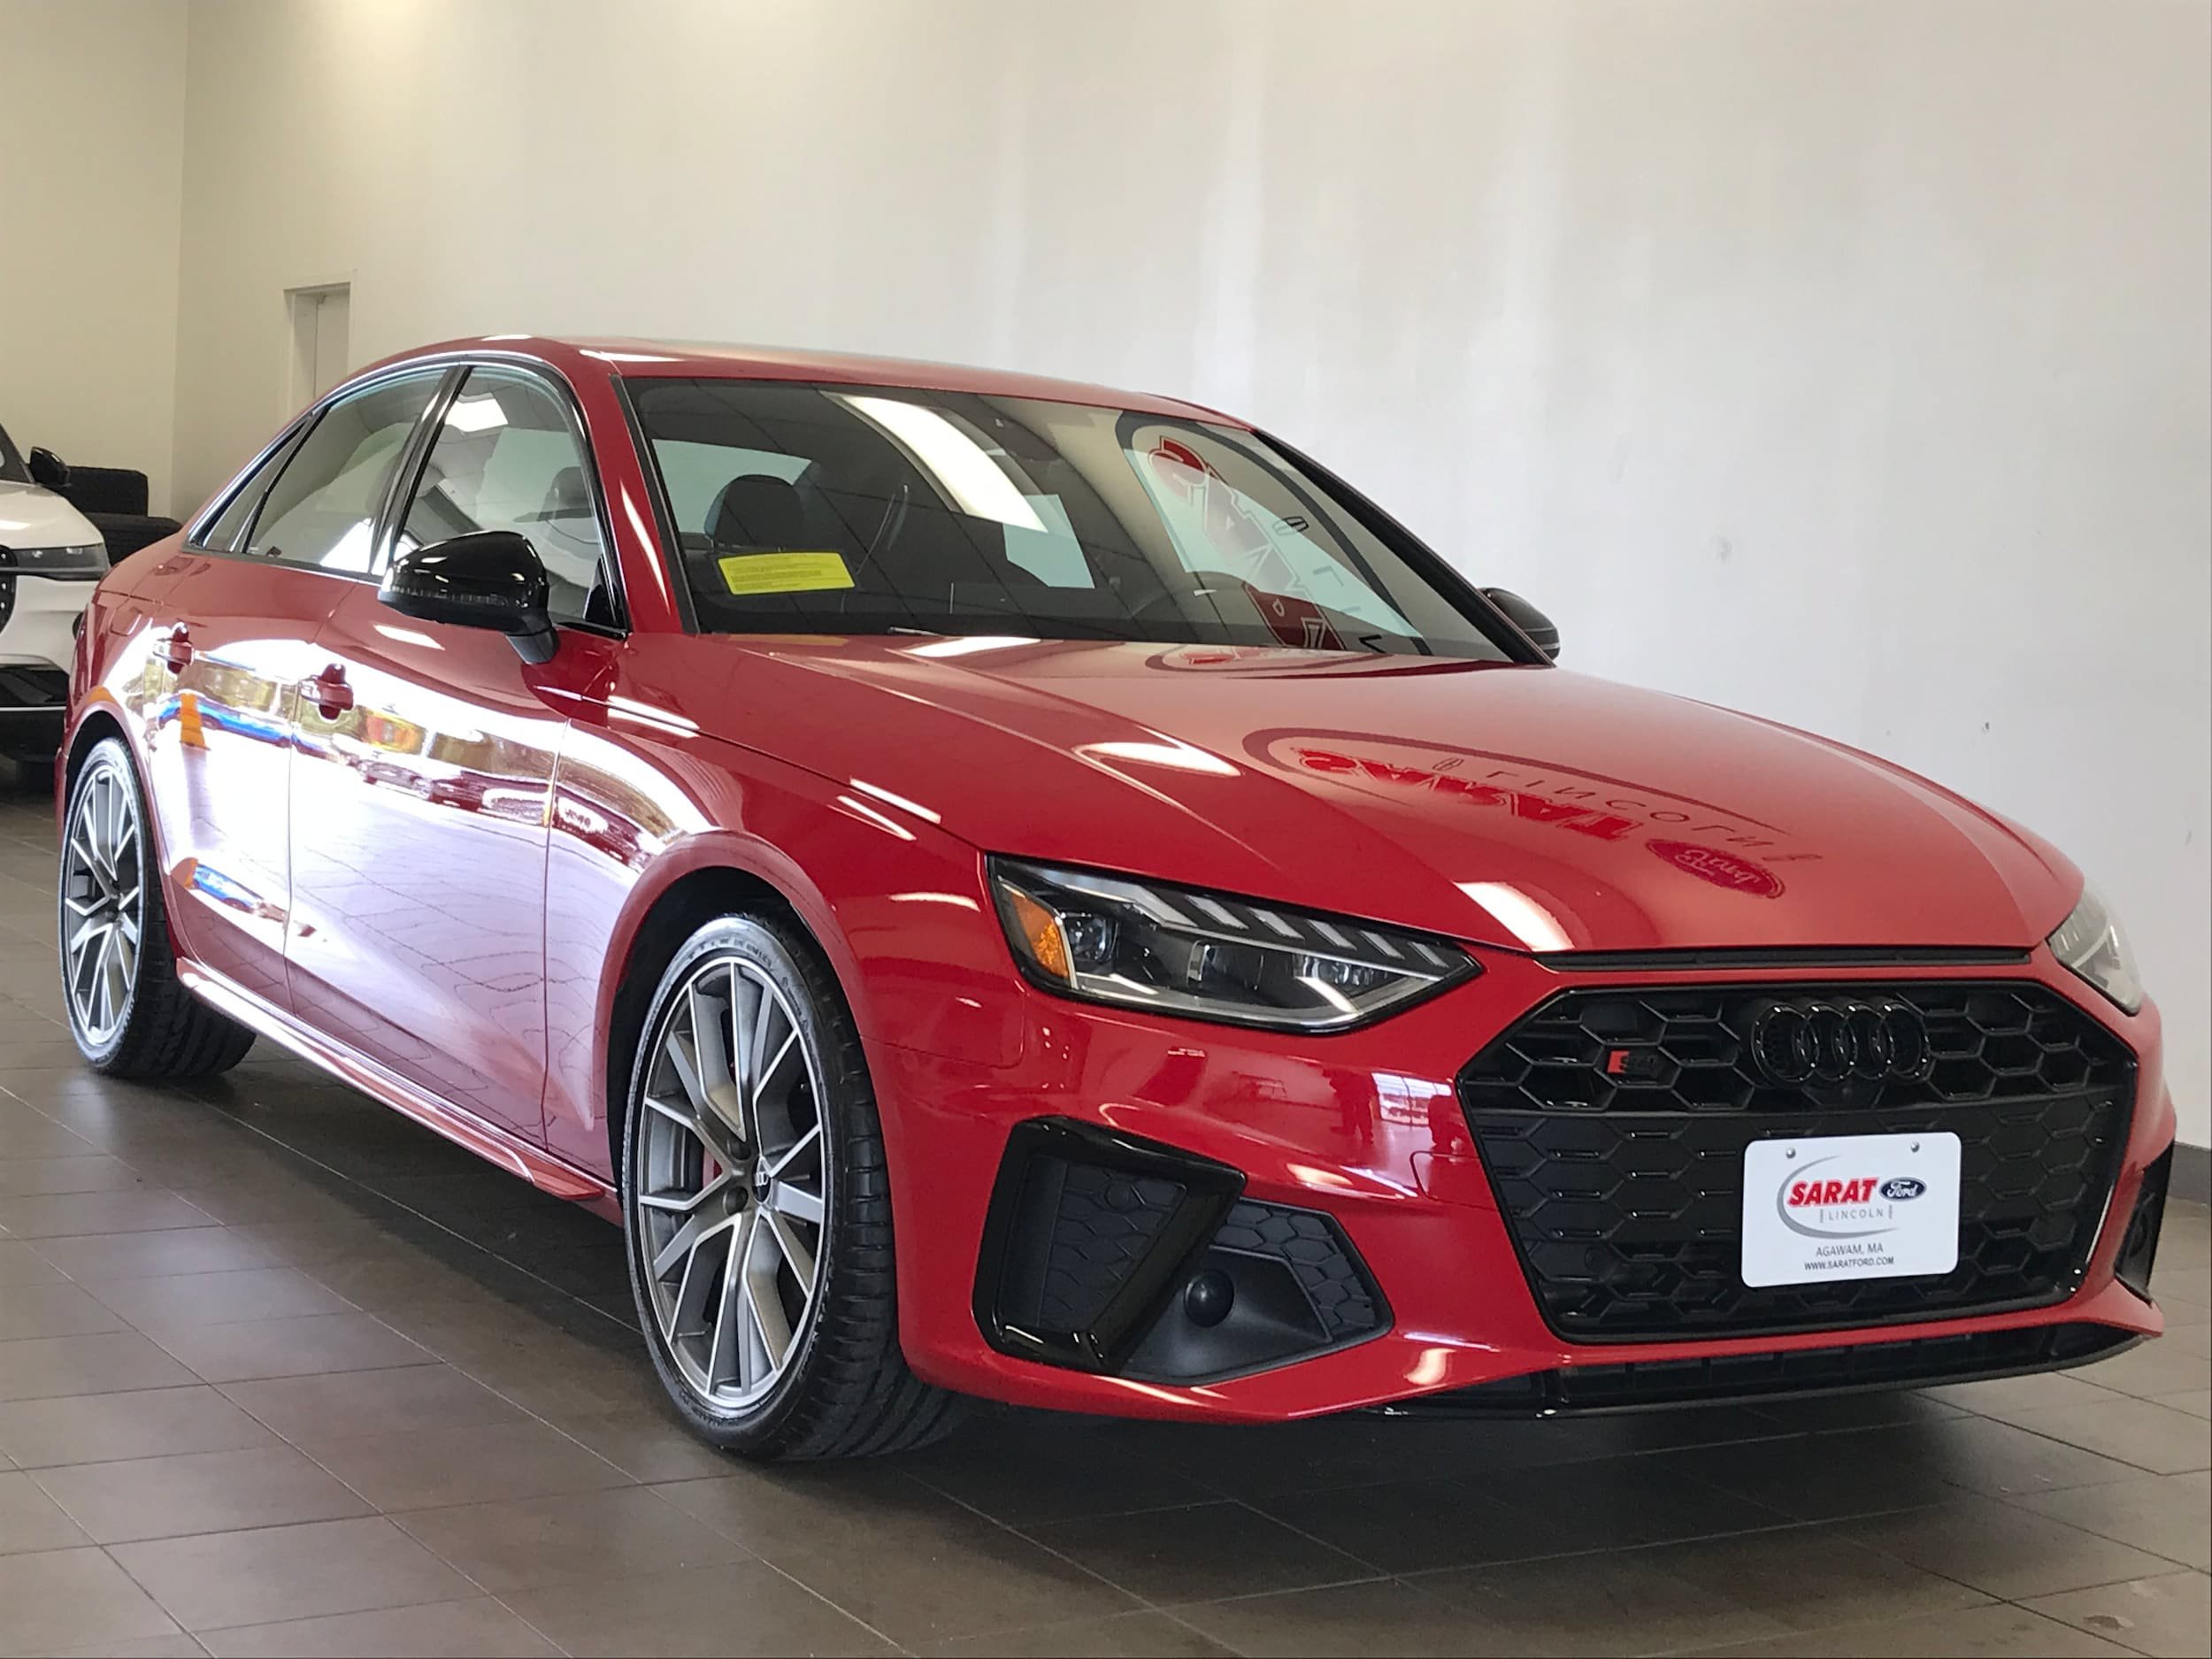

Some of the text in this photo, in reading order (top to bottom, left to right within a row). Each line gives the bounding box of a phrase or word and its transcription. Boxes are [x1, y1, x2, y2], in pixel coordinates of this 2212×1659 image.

[1788, 1178, 1918, 1207] SARAT Ford
[1828, 1209, 1883, 1220] LINCOLN
[1816, 1242, 1884, 1257] AGAWAM, MA
[1804, 1256, 1894, 1271] WWW.SARATFORD.COM
